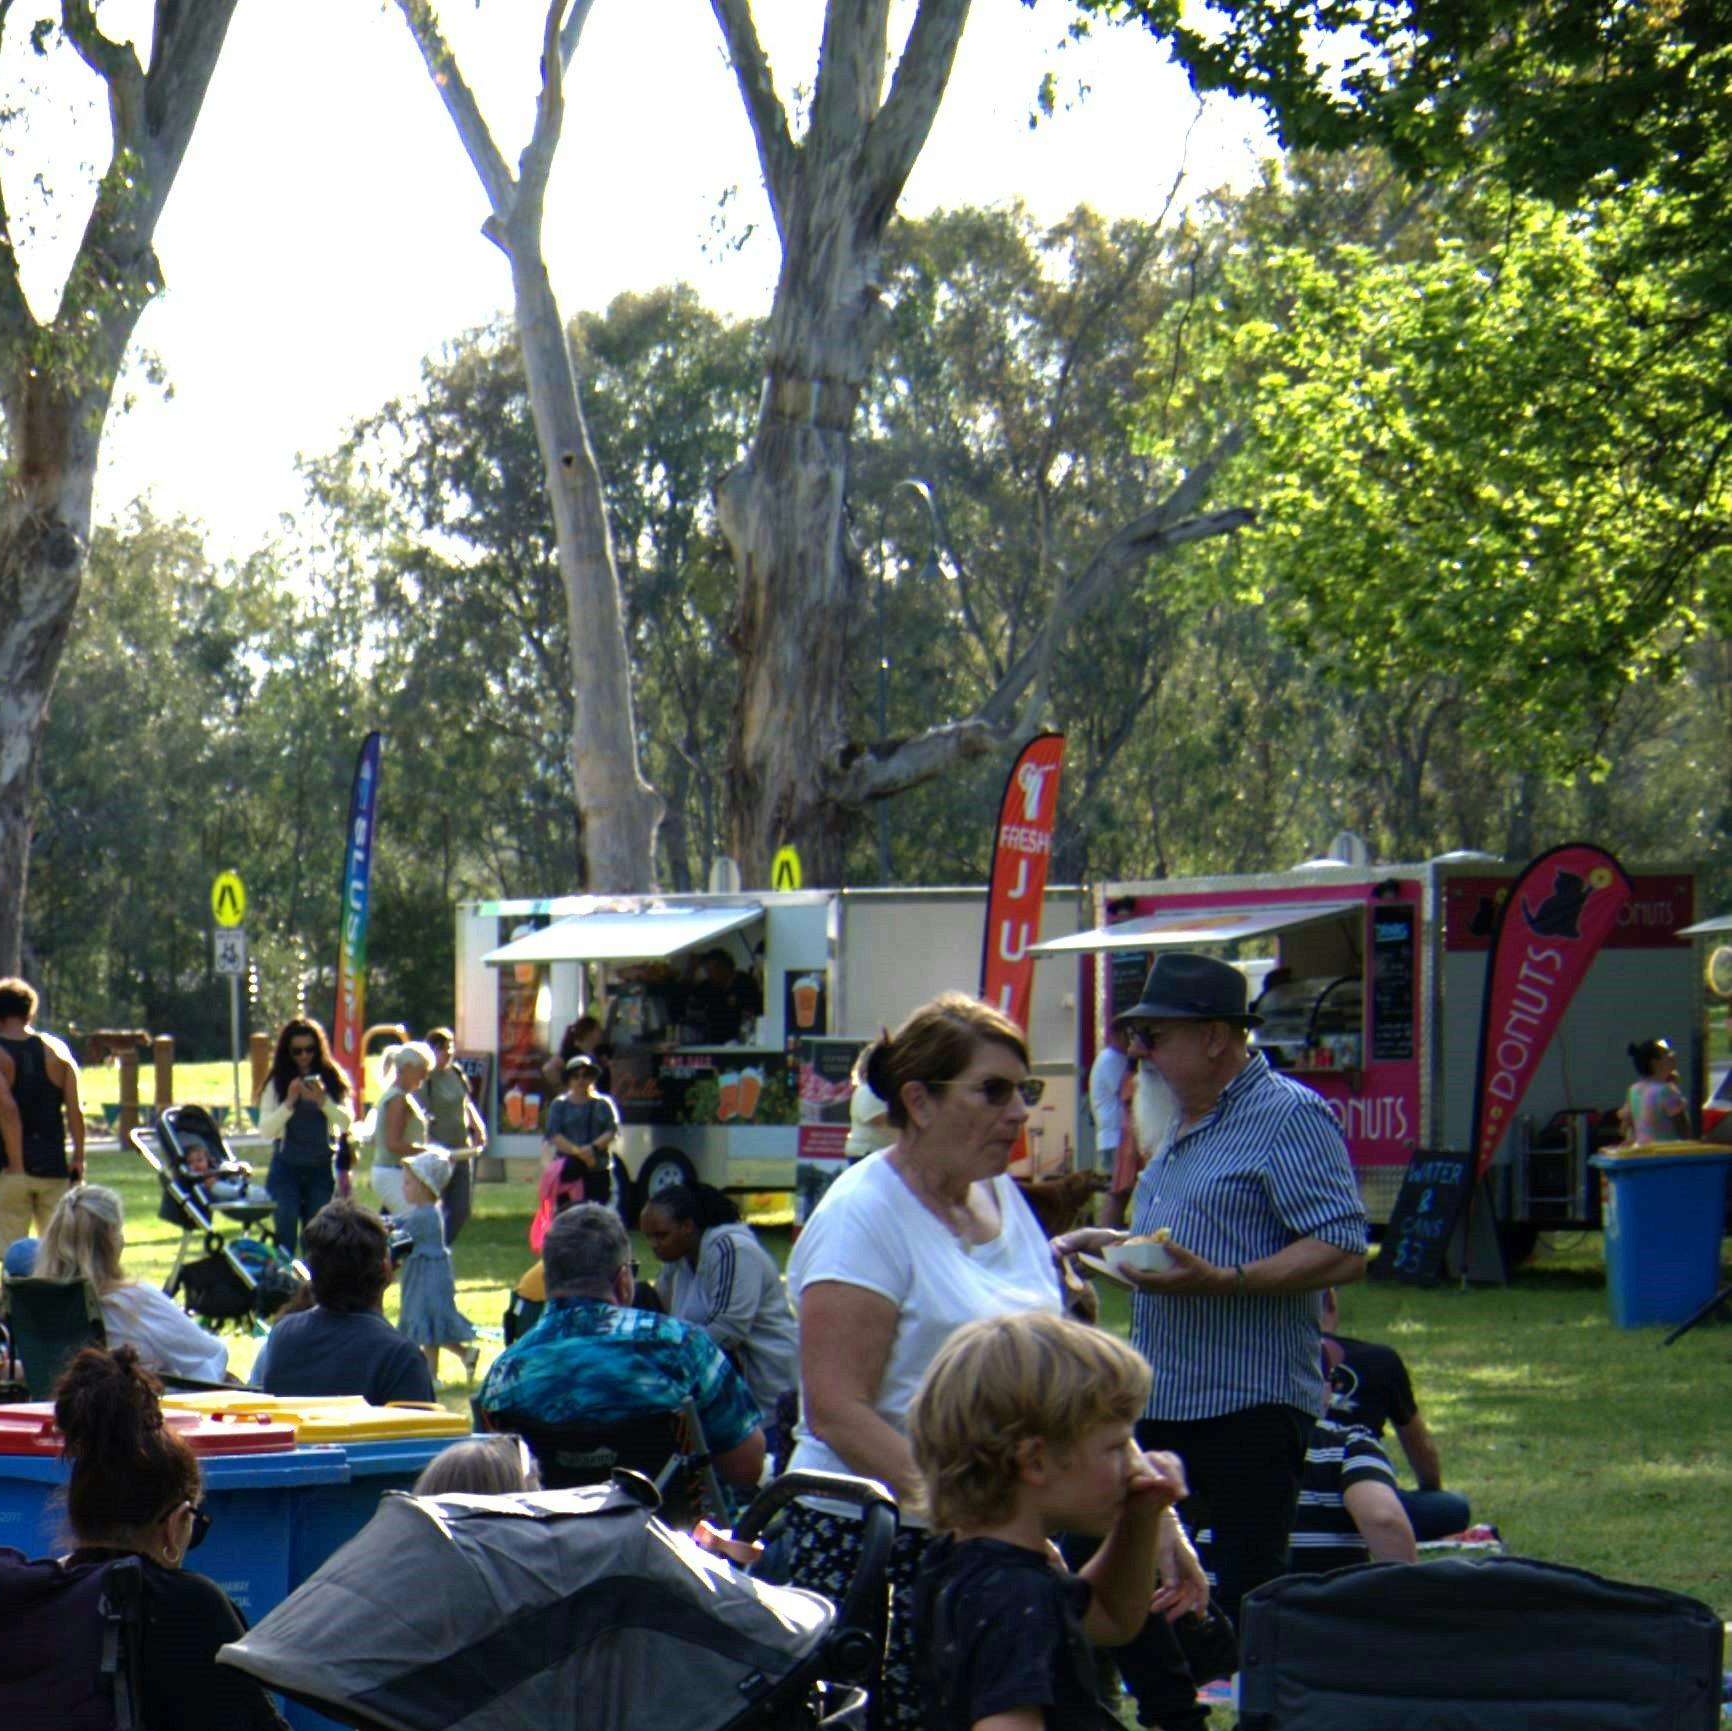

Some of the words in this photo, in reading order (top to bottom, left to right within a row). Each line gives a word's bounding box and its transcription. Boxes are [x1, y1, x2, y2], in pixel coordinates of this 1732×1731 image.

[999, 824, 1051, 856] FRESH
[1616, 900, 1674, 927] ONUTS
[999, 858, 1029, 1015] JUI
[1488, 944, 1563, 1101] DONUTS
[1334, 1095, 1408, 1140] ONUTS
[1407, 1160, 1464, 1184] WATER
